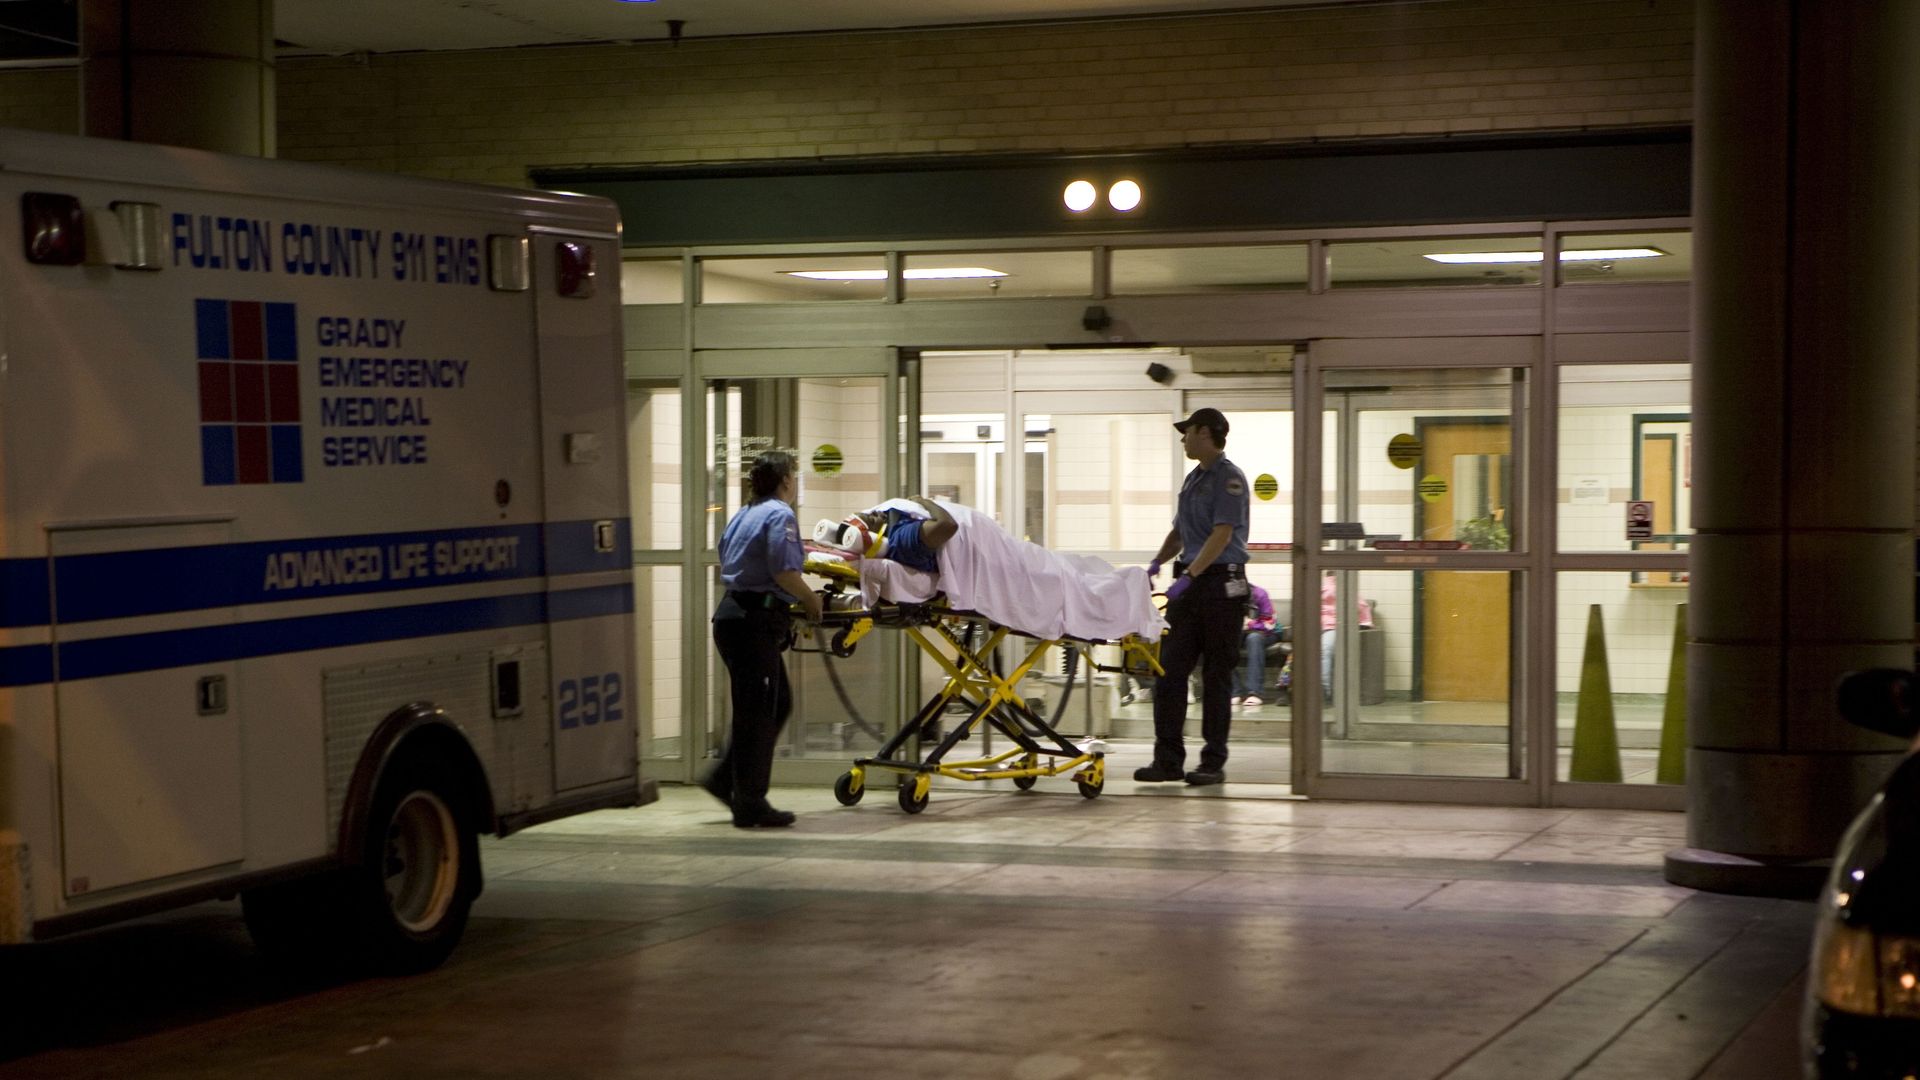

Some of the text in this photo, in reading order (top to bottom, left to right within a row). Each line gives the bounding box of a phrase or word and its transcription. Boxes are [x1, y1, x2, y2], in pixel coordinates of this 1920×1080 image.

[172, 213, 480, 285] FULTON COUNTY 911 EMS
[316, 316, 406, 348] GRADY
[319, 356, 469, 388] EMERGENCY
[320, 397, 432, 427] MEDICAL
[322, 434, 428, 467] SERVICE
[263, 536, 519, 591] ADVANCED LIFE SUPPORT
[559, 672, 623, 730] 252
